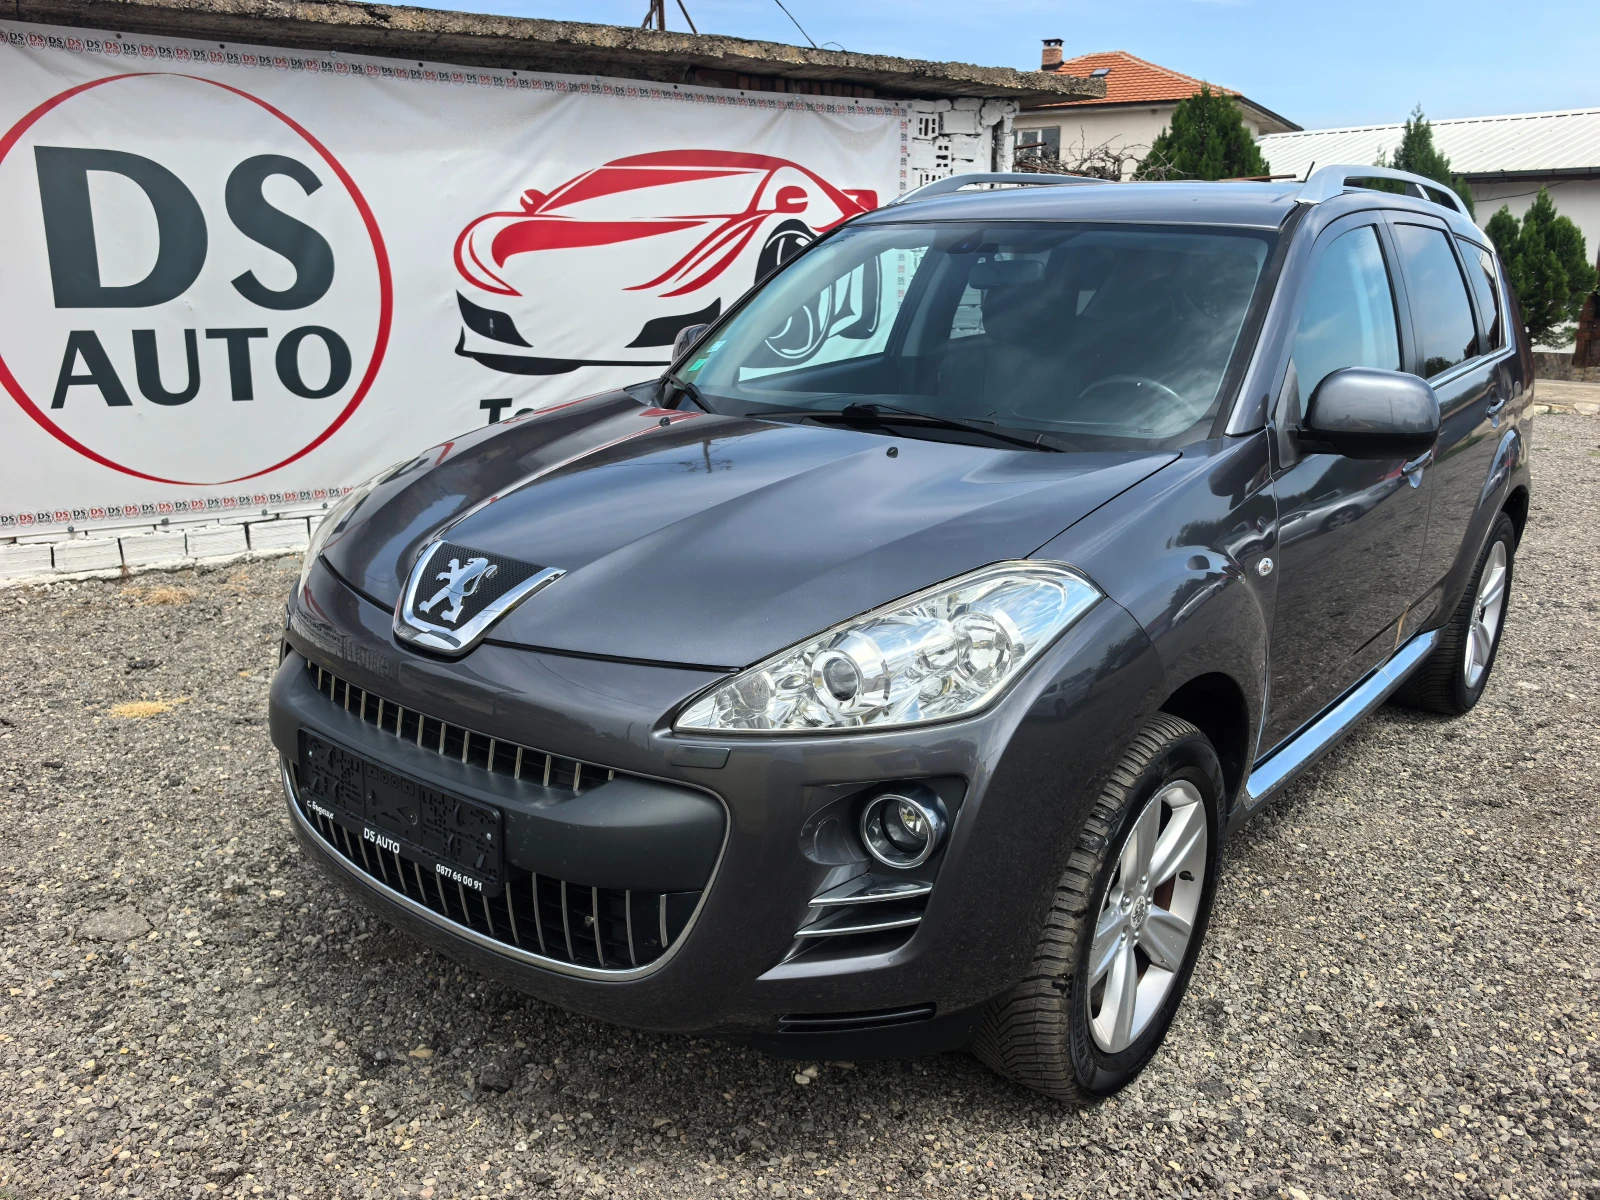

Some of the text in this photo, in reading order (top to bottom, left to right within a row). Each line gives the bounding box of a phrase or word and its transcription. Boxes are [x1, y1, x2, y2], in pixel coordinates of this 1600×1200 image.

[10, 32, 24, 41] DS
[29, 34, 43, 43] DS
[49, 36, 63, 45] DS
[68, 38, 81, 47] DS
[87, 40, 100, 48] DS
[105, 42, 119, 50] DS
[123, 43, 136, 51] DS
[141, 45, 154, 53] DS
[159, 47, 171, 55] DS
[176, 48, 189, 56] DS
[193, 50, 205, 58] DS
[210, 51, 222, 59] DS
[227, 53, 239, 61] DS
[243, 54, 255, 62] DS
[259, 56, 271, 64] DS
[275, 57, 287, 65] DS
[291, 59, 302, 67] DS
[307, 60, 318, 68] DS
[321, 61, 332, 69] DS
[352, 64, 362, 72] DS
[367, 65, 378, 73] DS
[382, 66, 392, 74] DS
[411, 69, 421, 77] DS
[425, 70, 435, 78] DS
[34, 145, 335, 311] DS
[50, 325, 352, 409] AUTO
[254, 494, 265, 502] DS
[142, 503, 154, 511] DS
[159, 502, 170, 510] DS
[192, 499, 203, 507] DS
[38, 512, 50, 520] DS
[73, 509, 86, 517] DS
[2, 515, 14, 523] DS
[363, 827, 400, 854] DS AUTO
[435, 863, 483, 892] 0877 66 00 91
